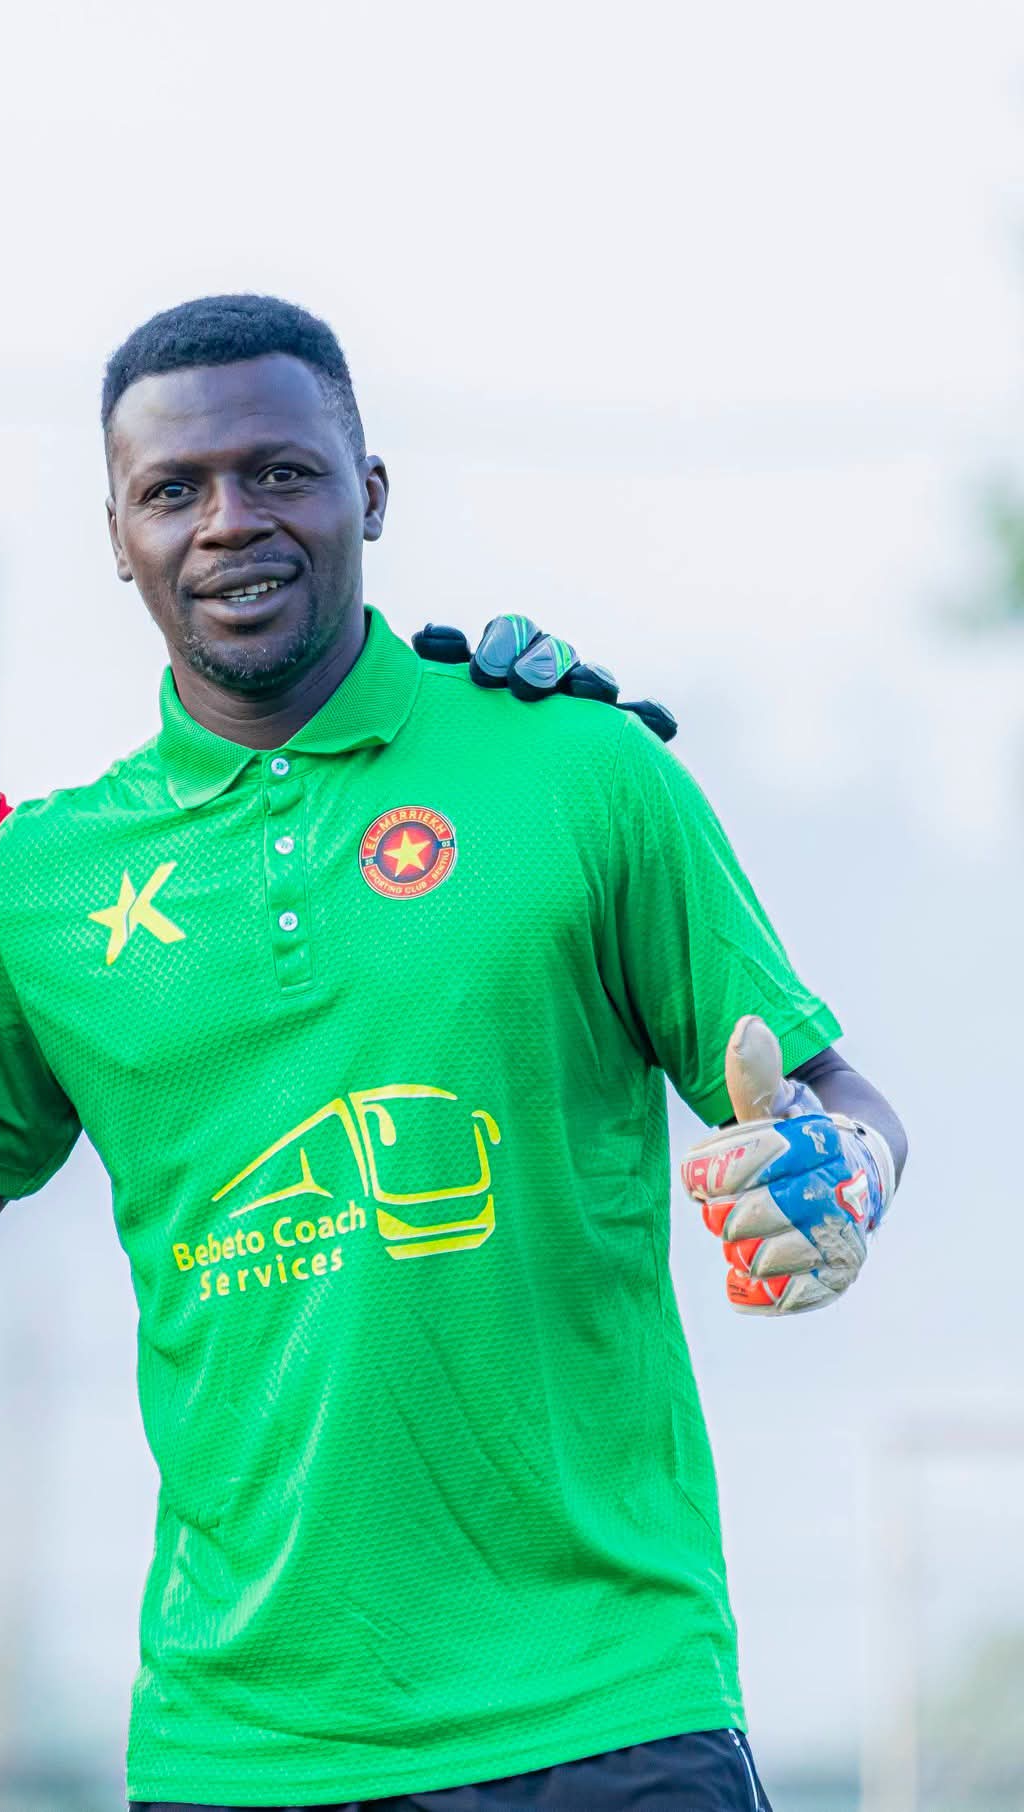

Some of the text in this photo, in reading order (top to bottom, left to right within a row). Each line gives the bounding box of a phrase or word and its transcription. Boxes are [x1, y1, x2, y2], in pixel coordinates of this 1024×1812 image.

[365, 810, 446, 850] EL-MERRIEKH
[172, 1199, 367, 1271] Bebeto Coach
[199, 1246, 344, 1301] Services
